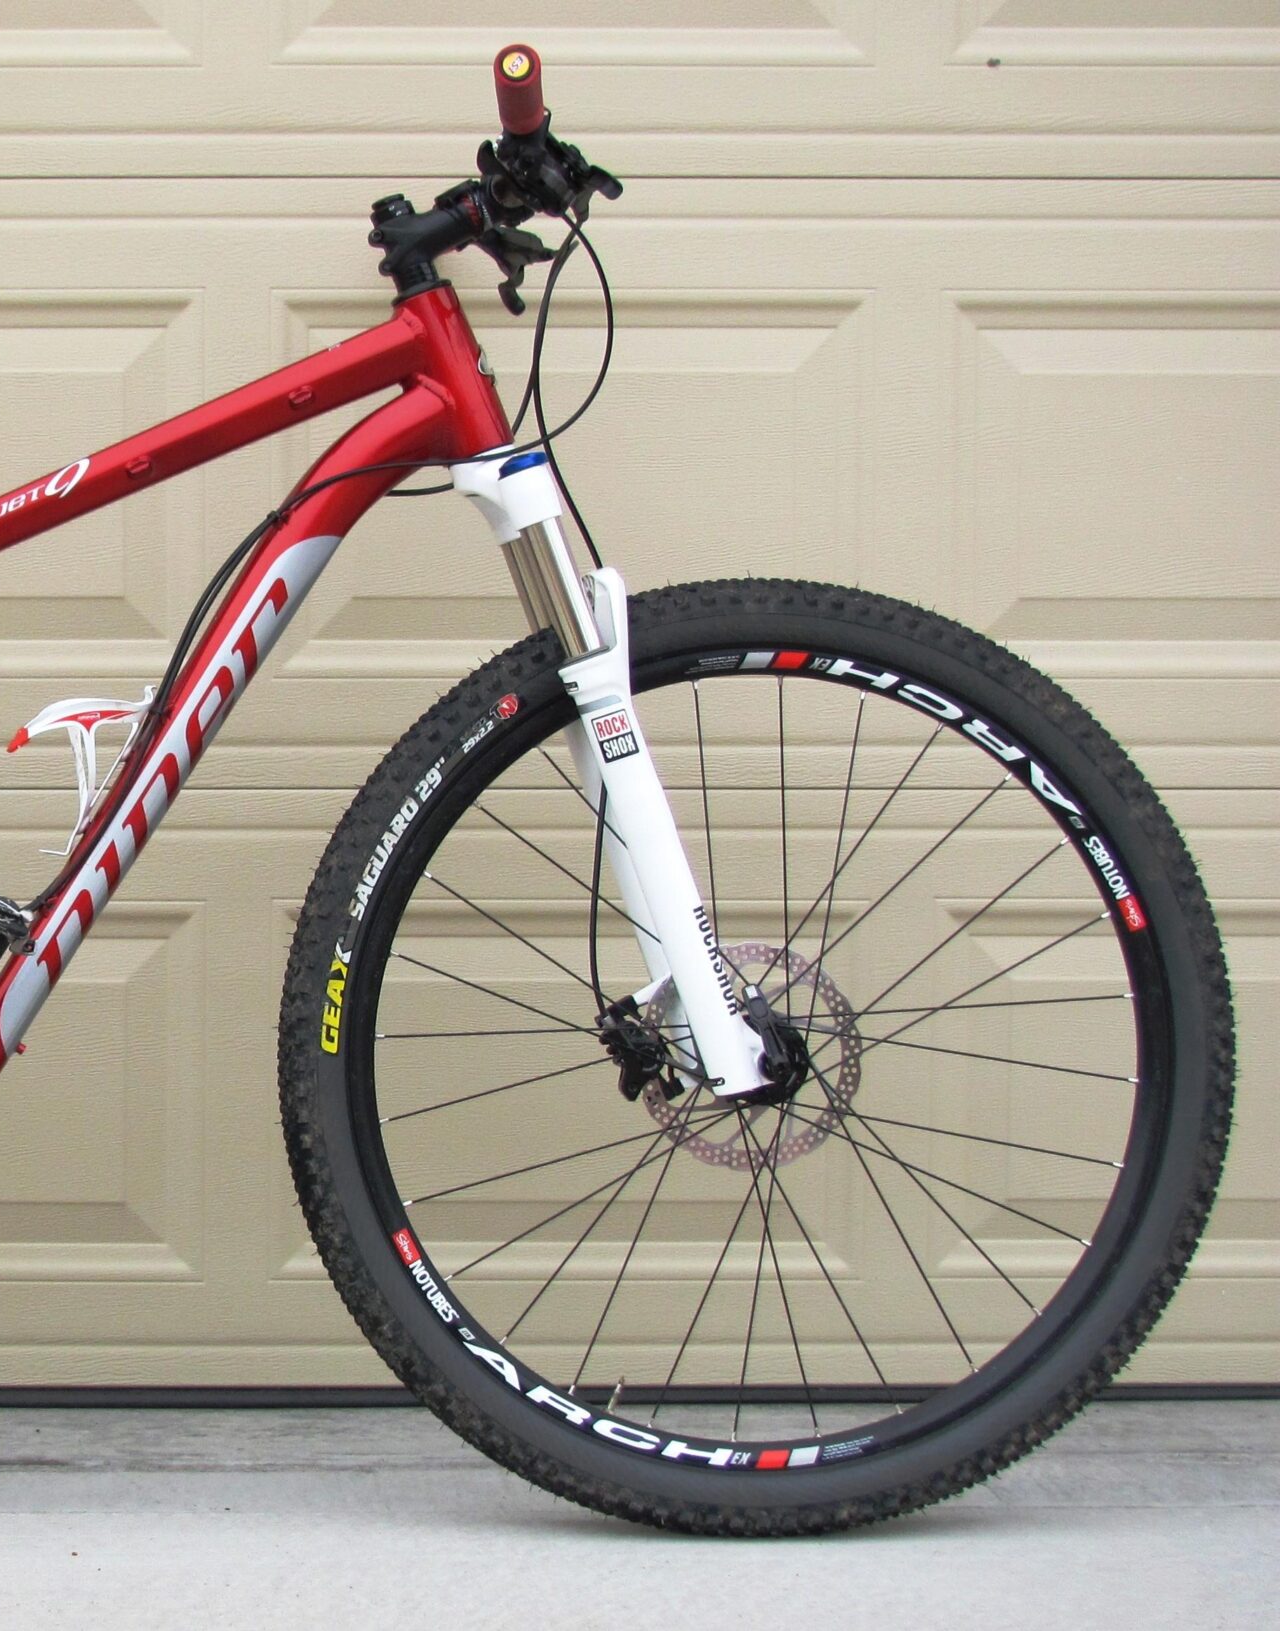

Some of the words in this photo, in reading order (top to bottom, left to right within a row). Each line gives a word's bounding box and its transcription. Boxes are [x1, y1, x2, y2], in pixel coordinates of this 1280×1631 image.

[595, 714, 628, 738] ROCK
[602, 733, 636, 759] SHOX
[826, 658, 1083, 816] ARCH
[1082, 835, 1131, 900] NOTUBES
[320, 941, 353, 1055] GEAX
[349, 793, 420, 921] SAGUARO
[408, 1258, 460, 1323] NOTUBES
[462, 1341, 733, 1468] ARCH
[729, 1451, 751, 1465] EX
